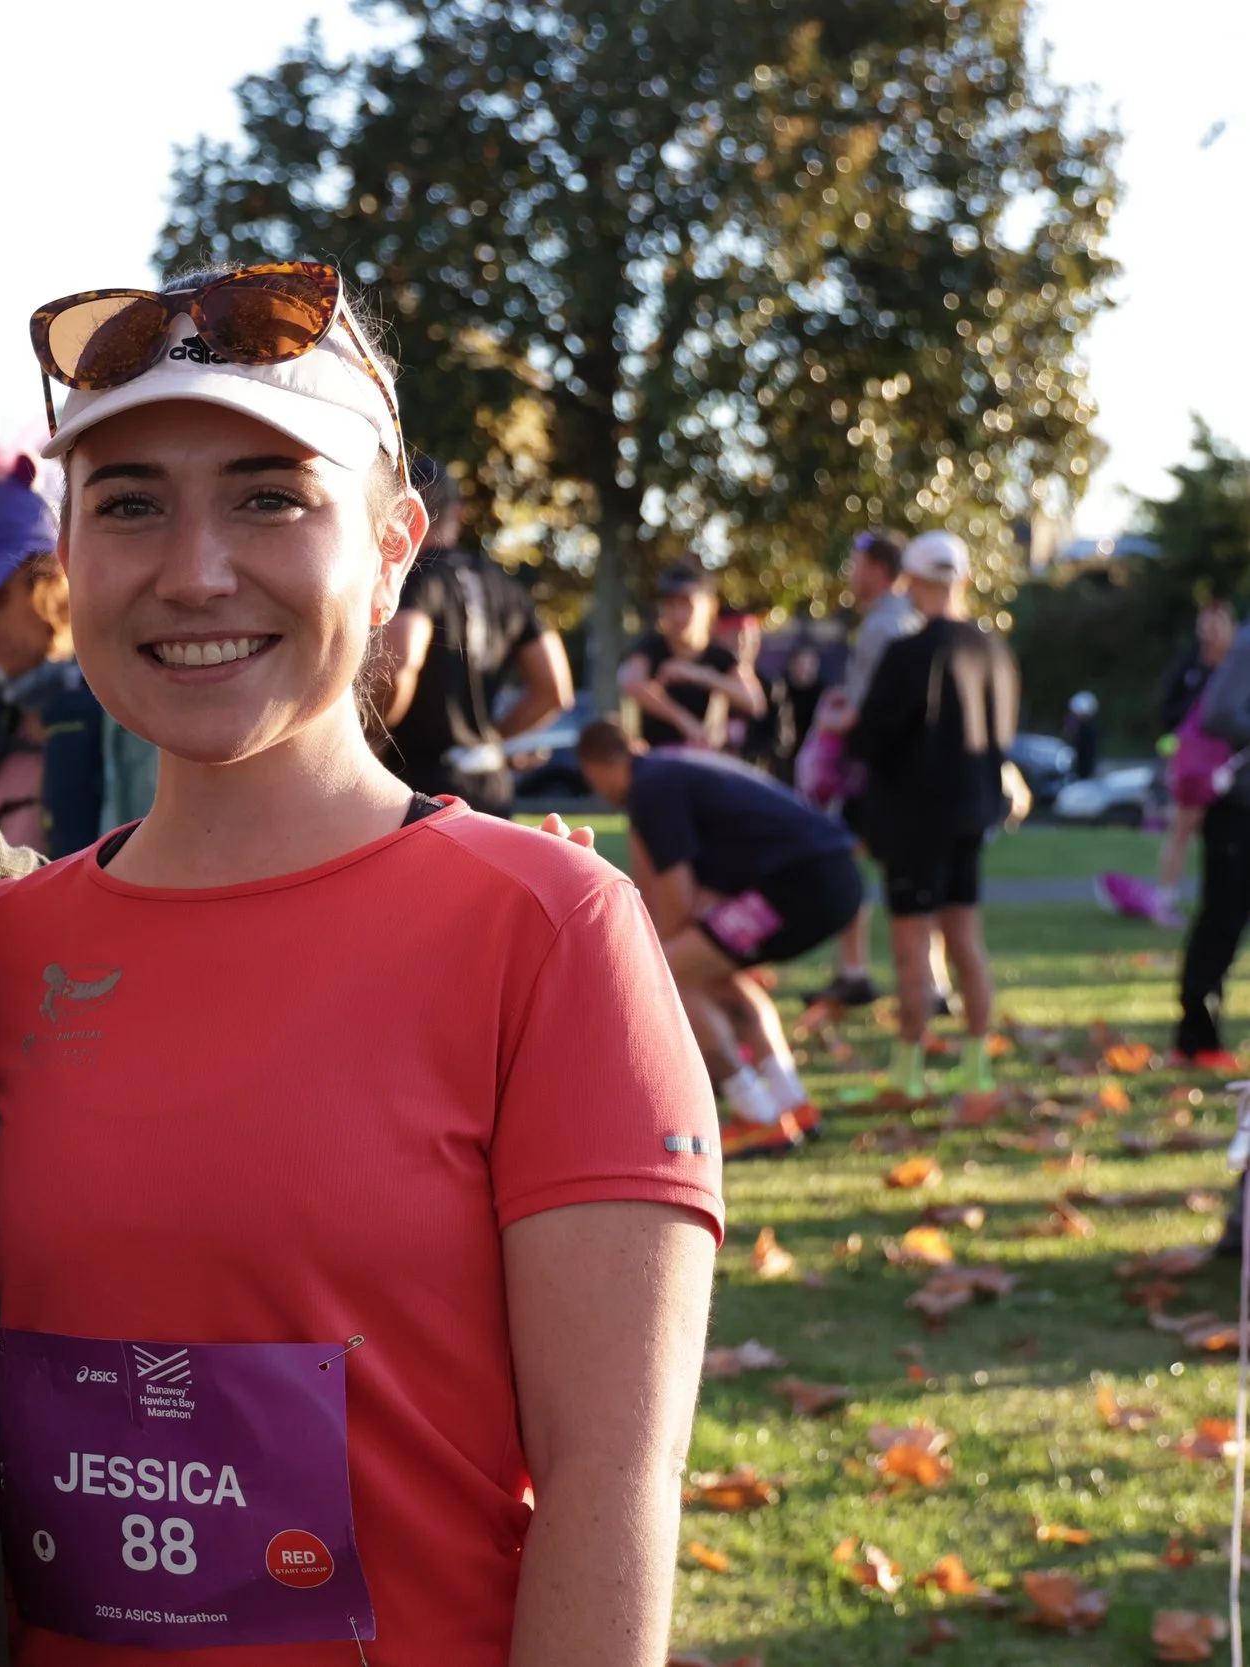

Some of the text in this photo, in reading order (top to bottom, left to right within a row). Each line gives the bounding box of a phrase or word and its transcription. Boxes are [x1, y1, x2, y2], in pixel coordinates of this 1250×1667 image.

[90, 1370, 117, 1383] asics
[139, 1395, 195, 1410] Hawke's Bay
[147, 1407, 191, 1419] Marathon
[53, 1452, 247, 1507] JESSICA
[121, 1513, 198, 1575] 88
[281, 1550, 316, 1564] RED
[95, 1605, 228, 1624] 2025 ASICS Marathon
